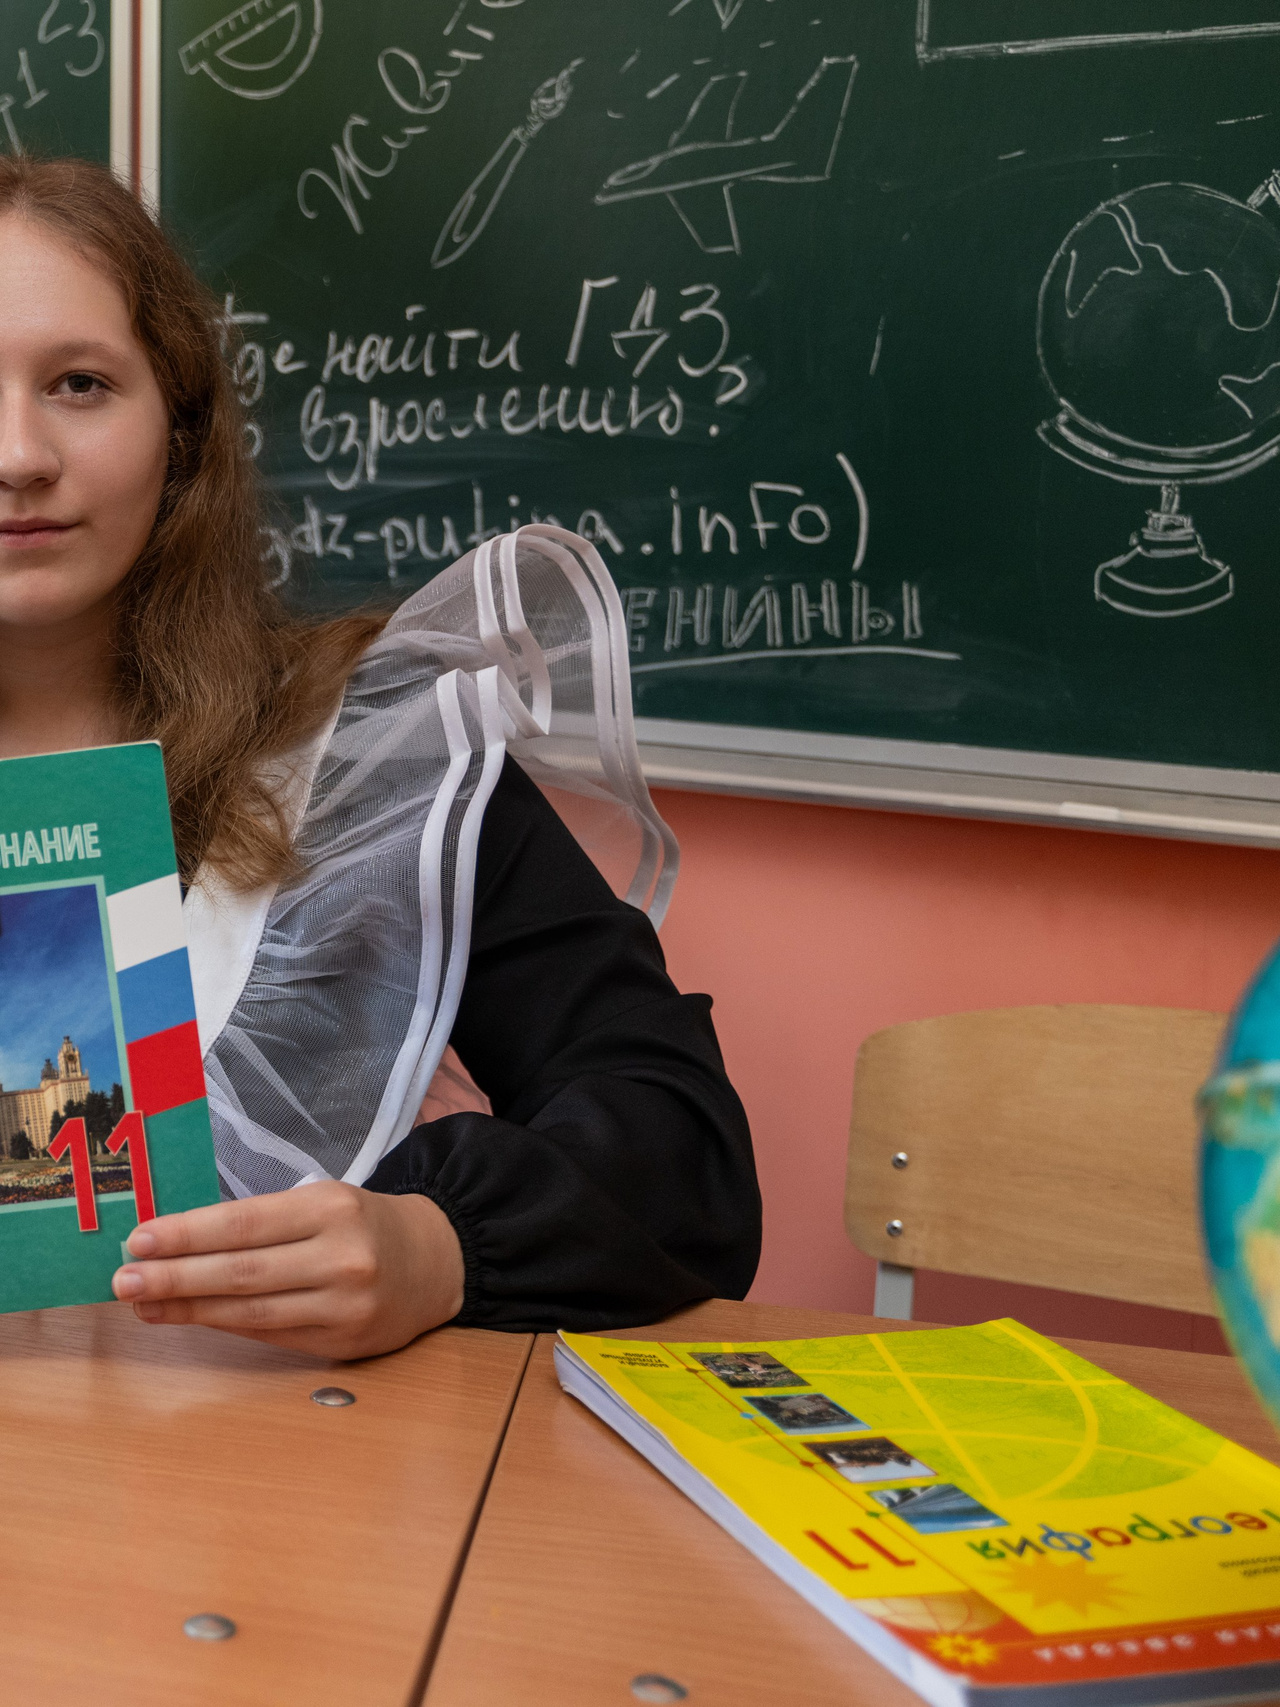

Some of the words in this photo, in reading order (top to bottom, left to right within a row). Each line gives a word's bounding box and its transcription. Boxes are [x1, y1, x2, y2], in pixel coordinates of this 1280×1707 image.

[321, 303, 523, 384] найти
[621, 578, 924, 652] ЕНИНЫ
[46, 1109, 158, 1232] 11
[801, 1527, 917, 1572] 11
